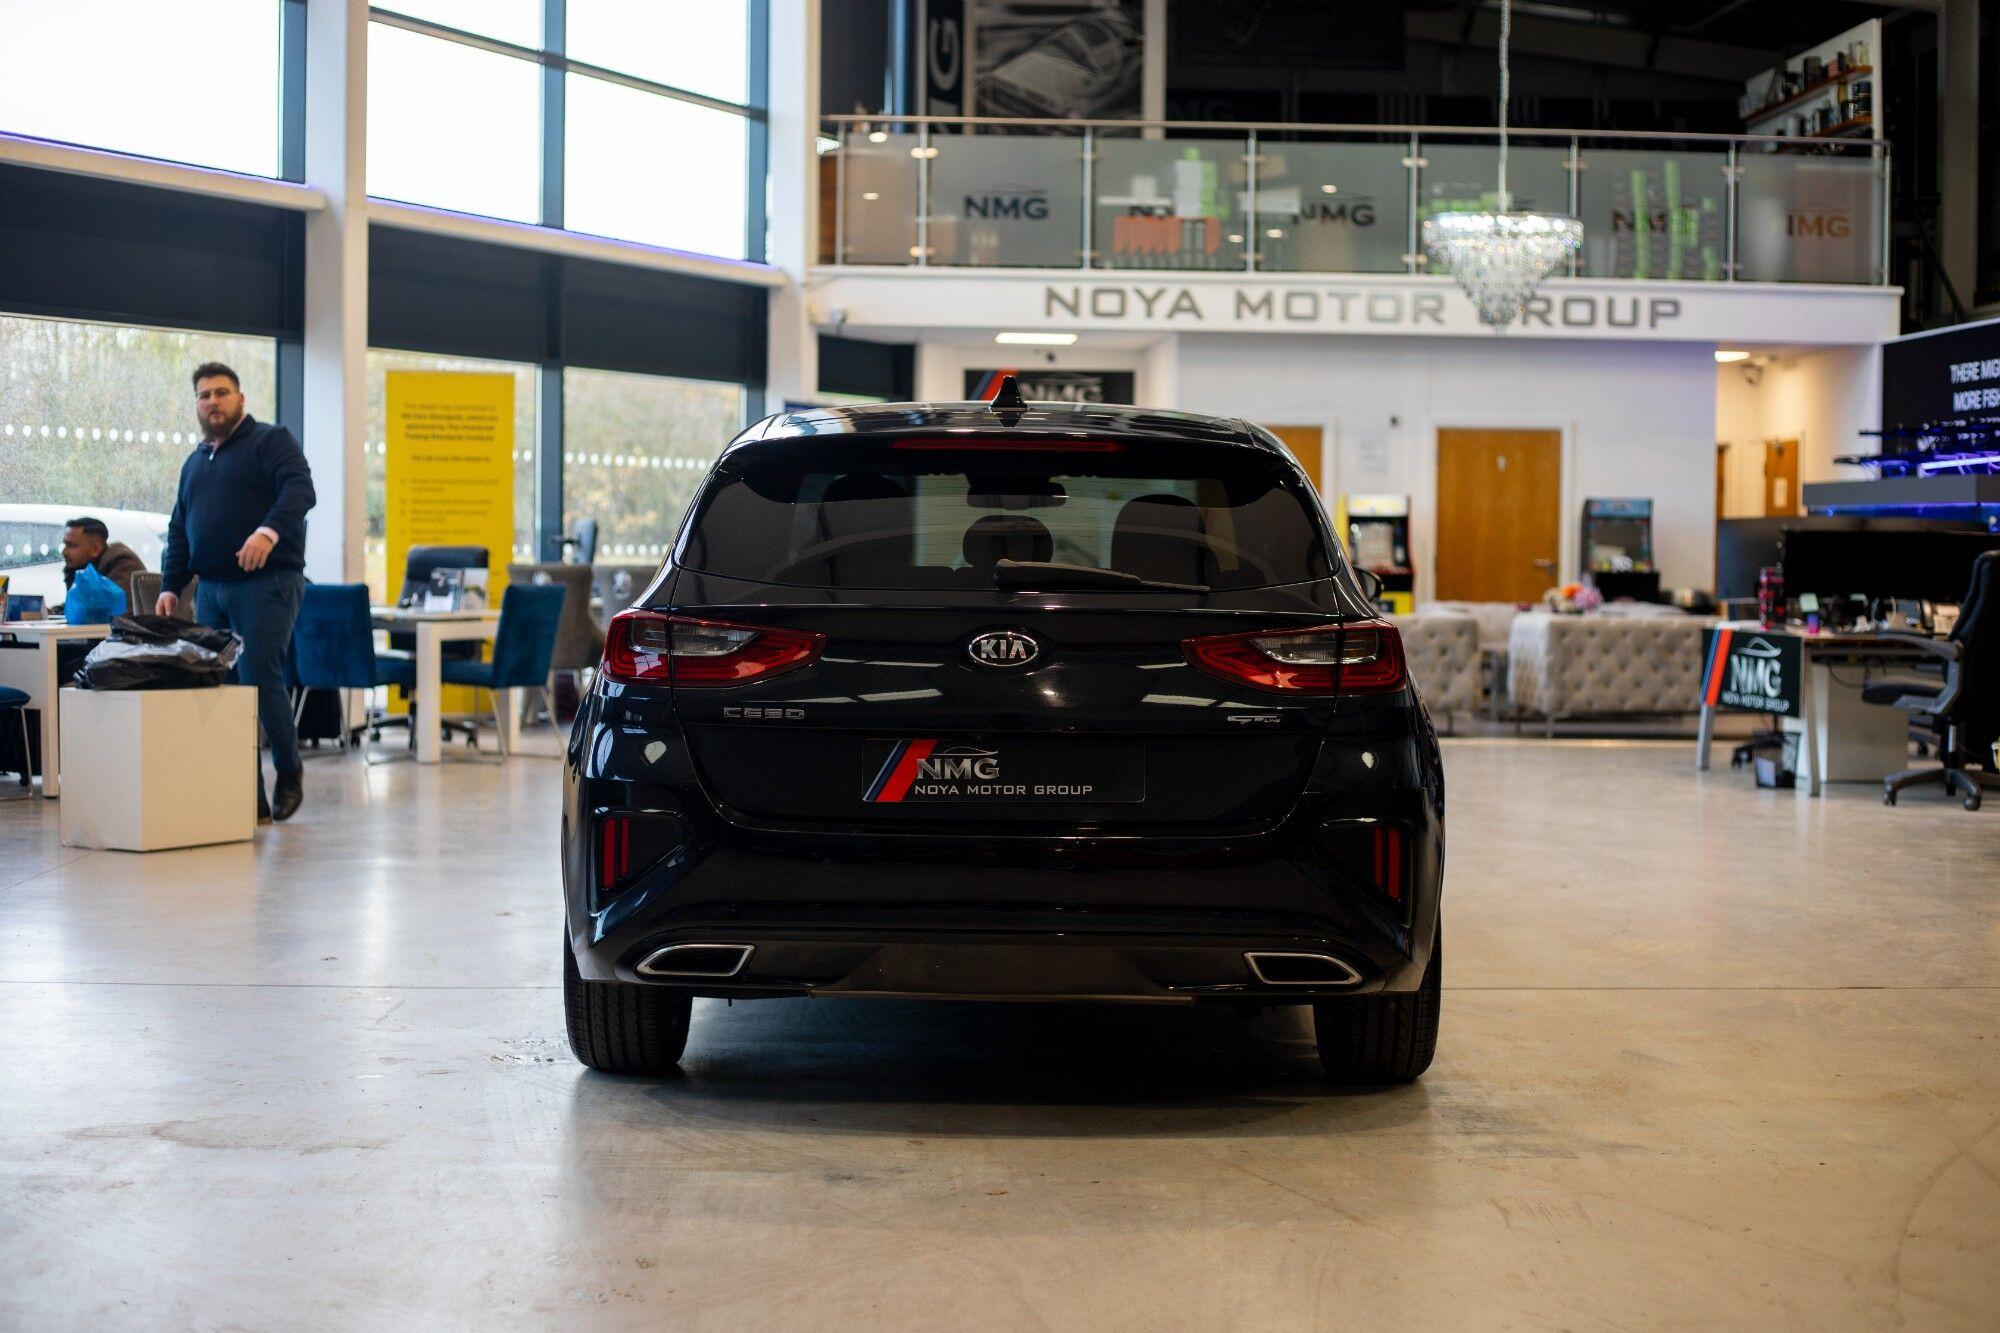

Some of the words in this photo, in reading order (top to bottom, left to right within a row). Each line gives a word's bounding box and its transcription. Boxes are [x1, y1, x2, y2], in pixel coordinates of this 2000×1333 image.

[963, 195, 1049, 220] NMG
[1045, 285, 1204, 319] NOYA
[1235, 287, 1446, 325] MOTOR
[1478, 294, 1682, 328] ROUP
[980, 639, 1027, 659] KIA
[1730, 654, 1782, 698] NMG
[1764, 696, 1790, 712] GROUP
[916, 758, 1000, 780] NMG
[914, 785, 960, 796] NOYA
[967, 785, 1026, 796] MOTOR
[1034, 785, 1093, 796] GROUP
